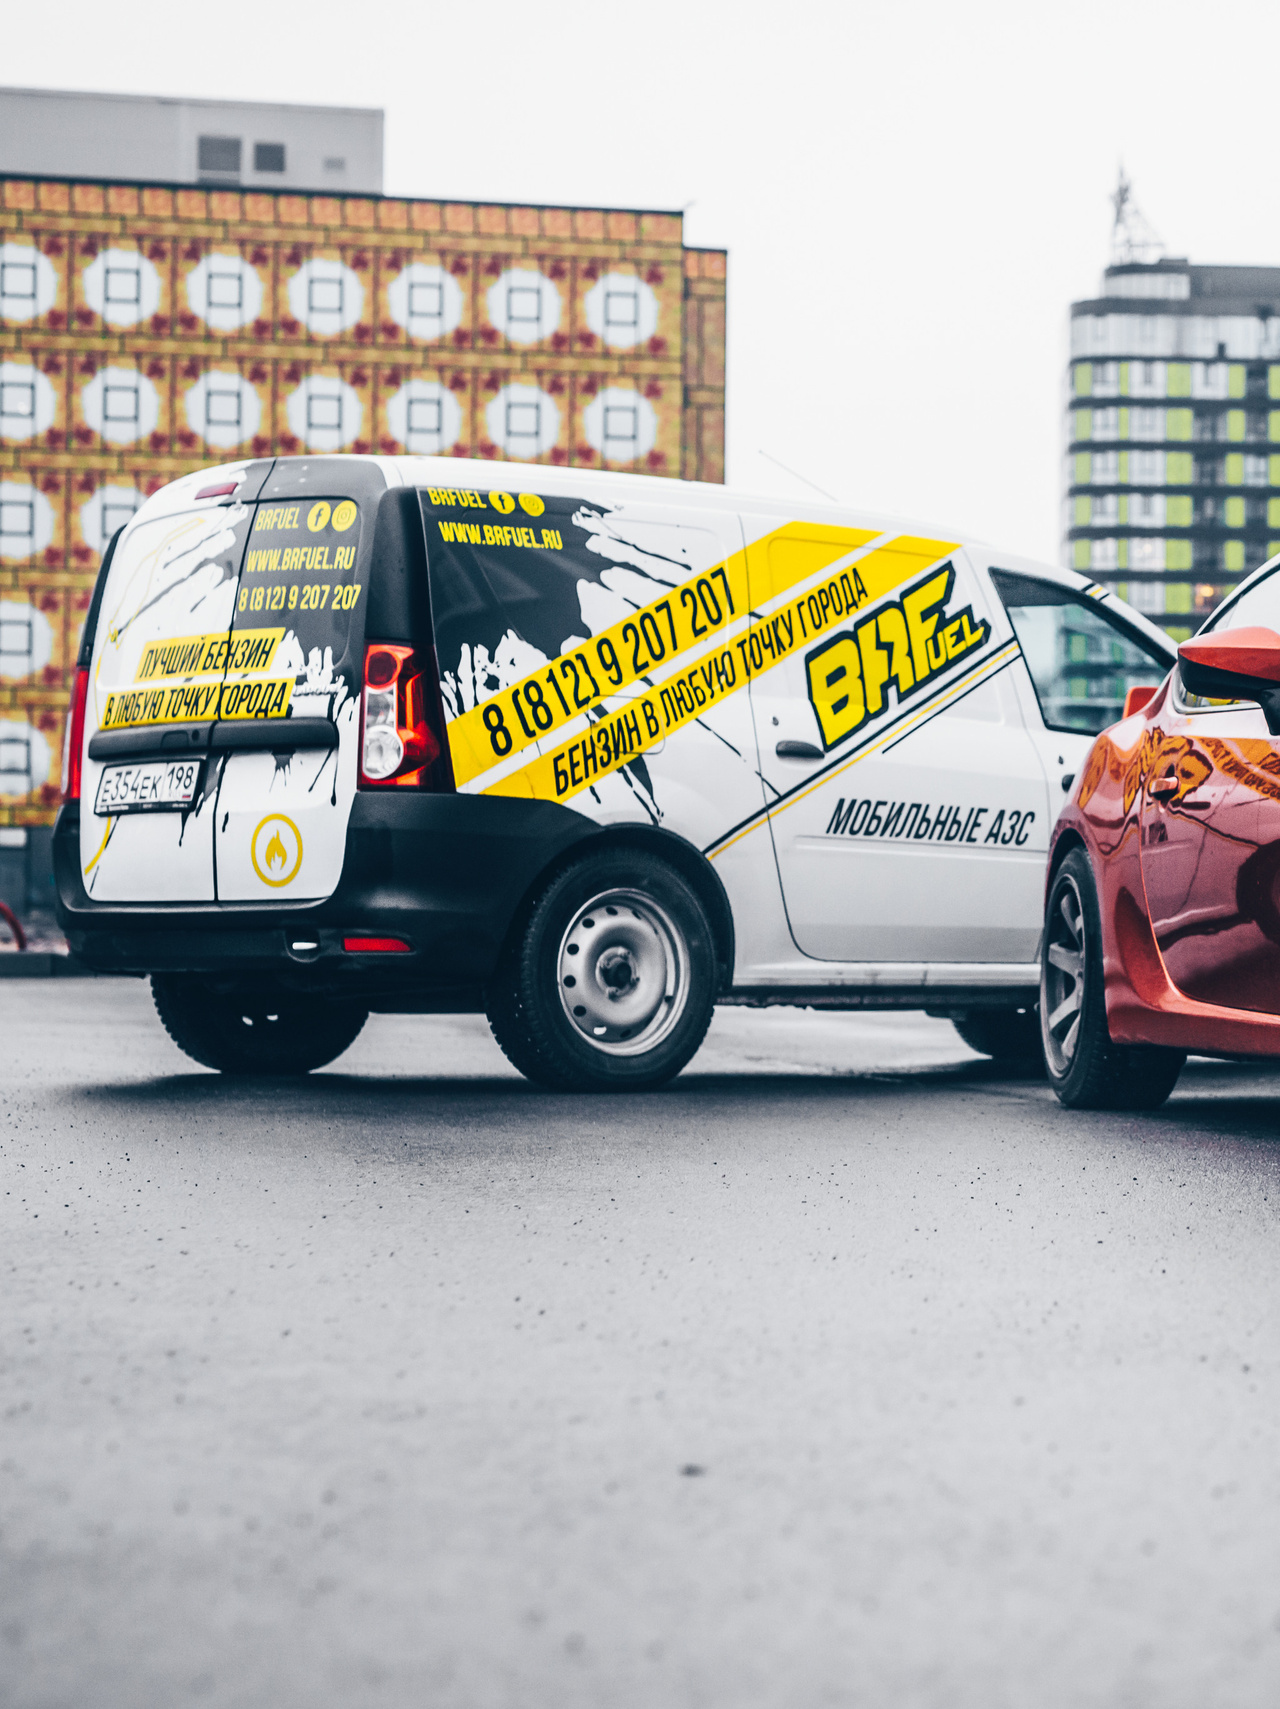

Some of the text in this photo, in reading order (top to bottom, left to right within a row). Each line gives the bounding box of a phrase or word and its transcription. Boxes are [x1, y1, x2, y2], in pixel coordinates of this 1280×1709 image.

[427, 487, 487, 509] BRFUEL
[254, 506, 300, 532] BRFUEL
[438, 521, 563, 550] WWW.BRFUEL.RU
[246, 546, 356, 573] WWW.BRFUEL.RU
[238, 584, 362, 612] 8 (812) 9 207 207
[139, 636, 277, 680] ЛУЧШИЙ БЕНЗИН
[482, 567, 736, 757] 8 (812) 9 207 207
[552, 567, 868, 797] БЕНЗИН В ЛЮБУЮ ТОЧКУ ГОРОДА
[104, 680, 288, 727] В ЛЮБУЮ ТОЧКУ ГОРОДА
[167, 765, 194, 790] 198
[826, 797, 1036, 846] МОБИЛЬНЫЕ АЗС
